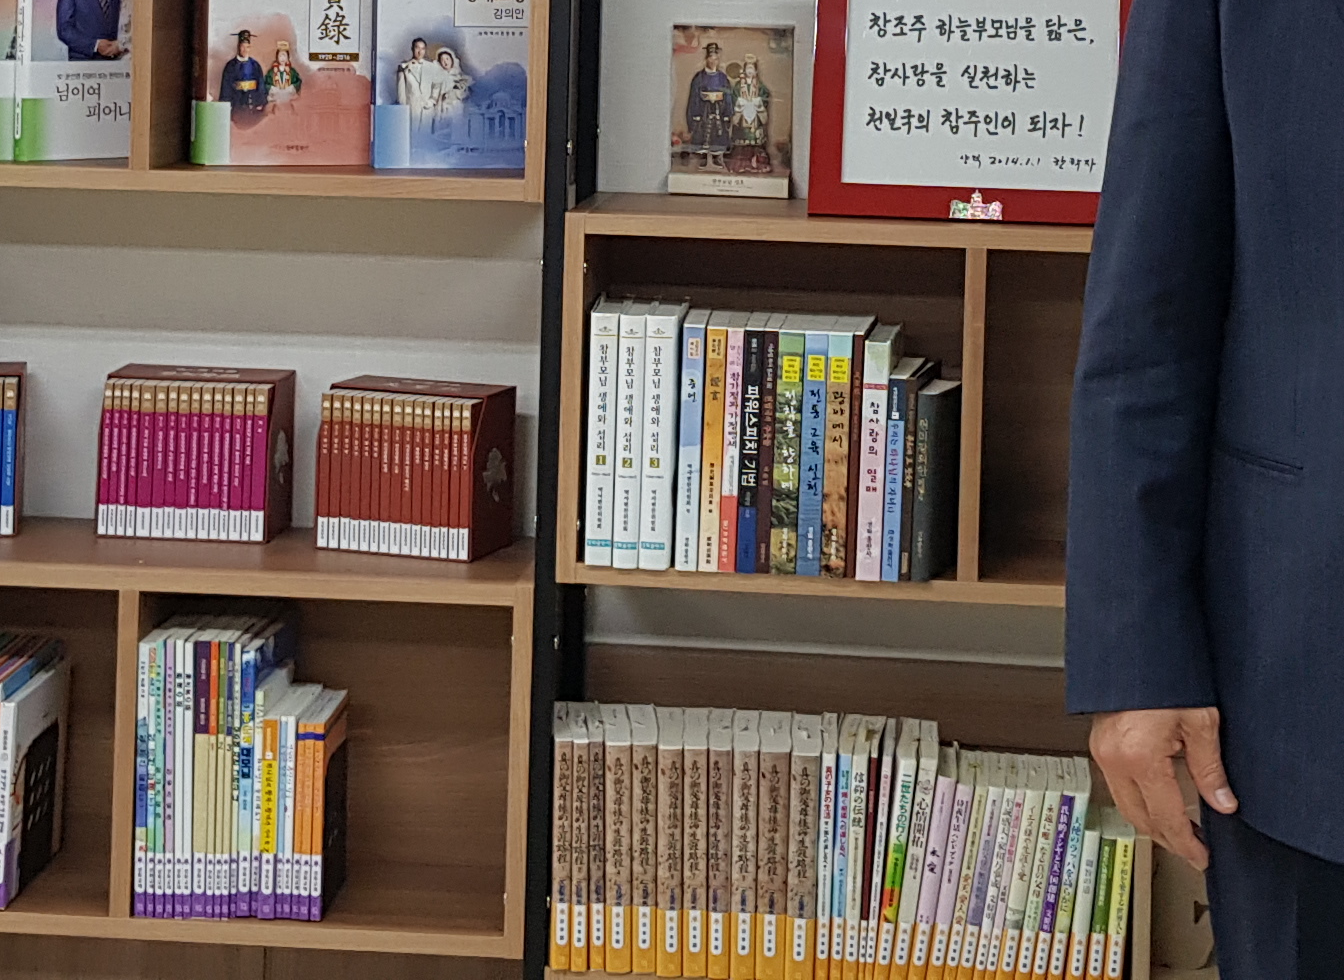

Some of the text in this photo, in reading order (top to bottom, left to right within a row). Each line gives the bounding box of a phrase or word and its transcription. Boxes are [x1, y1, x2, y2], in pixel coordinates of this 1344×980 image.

[868, 12, 1094, 44] 창조주 하늘부모님을 닮은,
[56, 83, 101, 102] 님이여
[868, 62, 1036, 92] 참사랑을 실천하는
[866, 107, 930, 135] 천일국의
[941, 108, 1016, 137] 참주인이
[596, 343, 609, 465] 참부모님 생애와 섭리 1
[622, 346, 635, 467] 참부모님 생애와 섭리 2
[649, 346, 662, 467] 참부모님 생애와 섭리 3
[868, 401, 880, 456] 참사랑의
[740, 385, 760, 487] 파워스피치 기법
